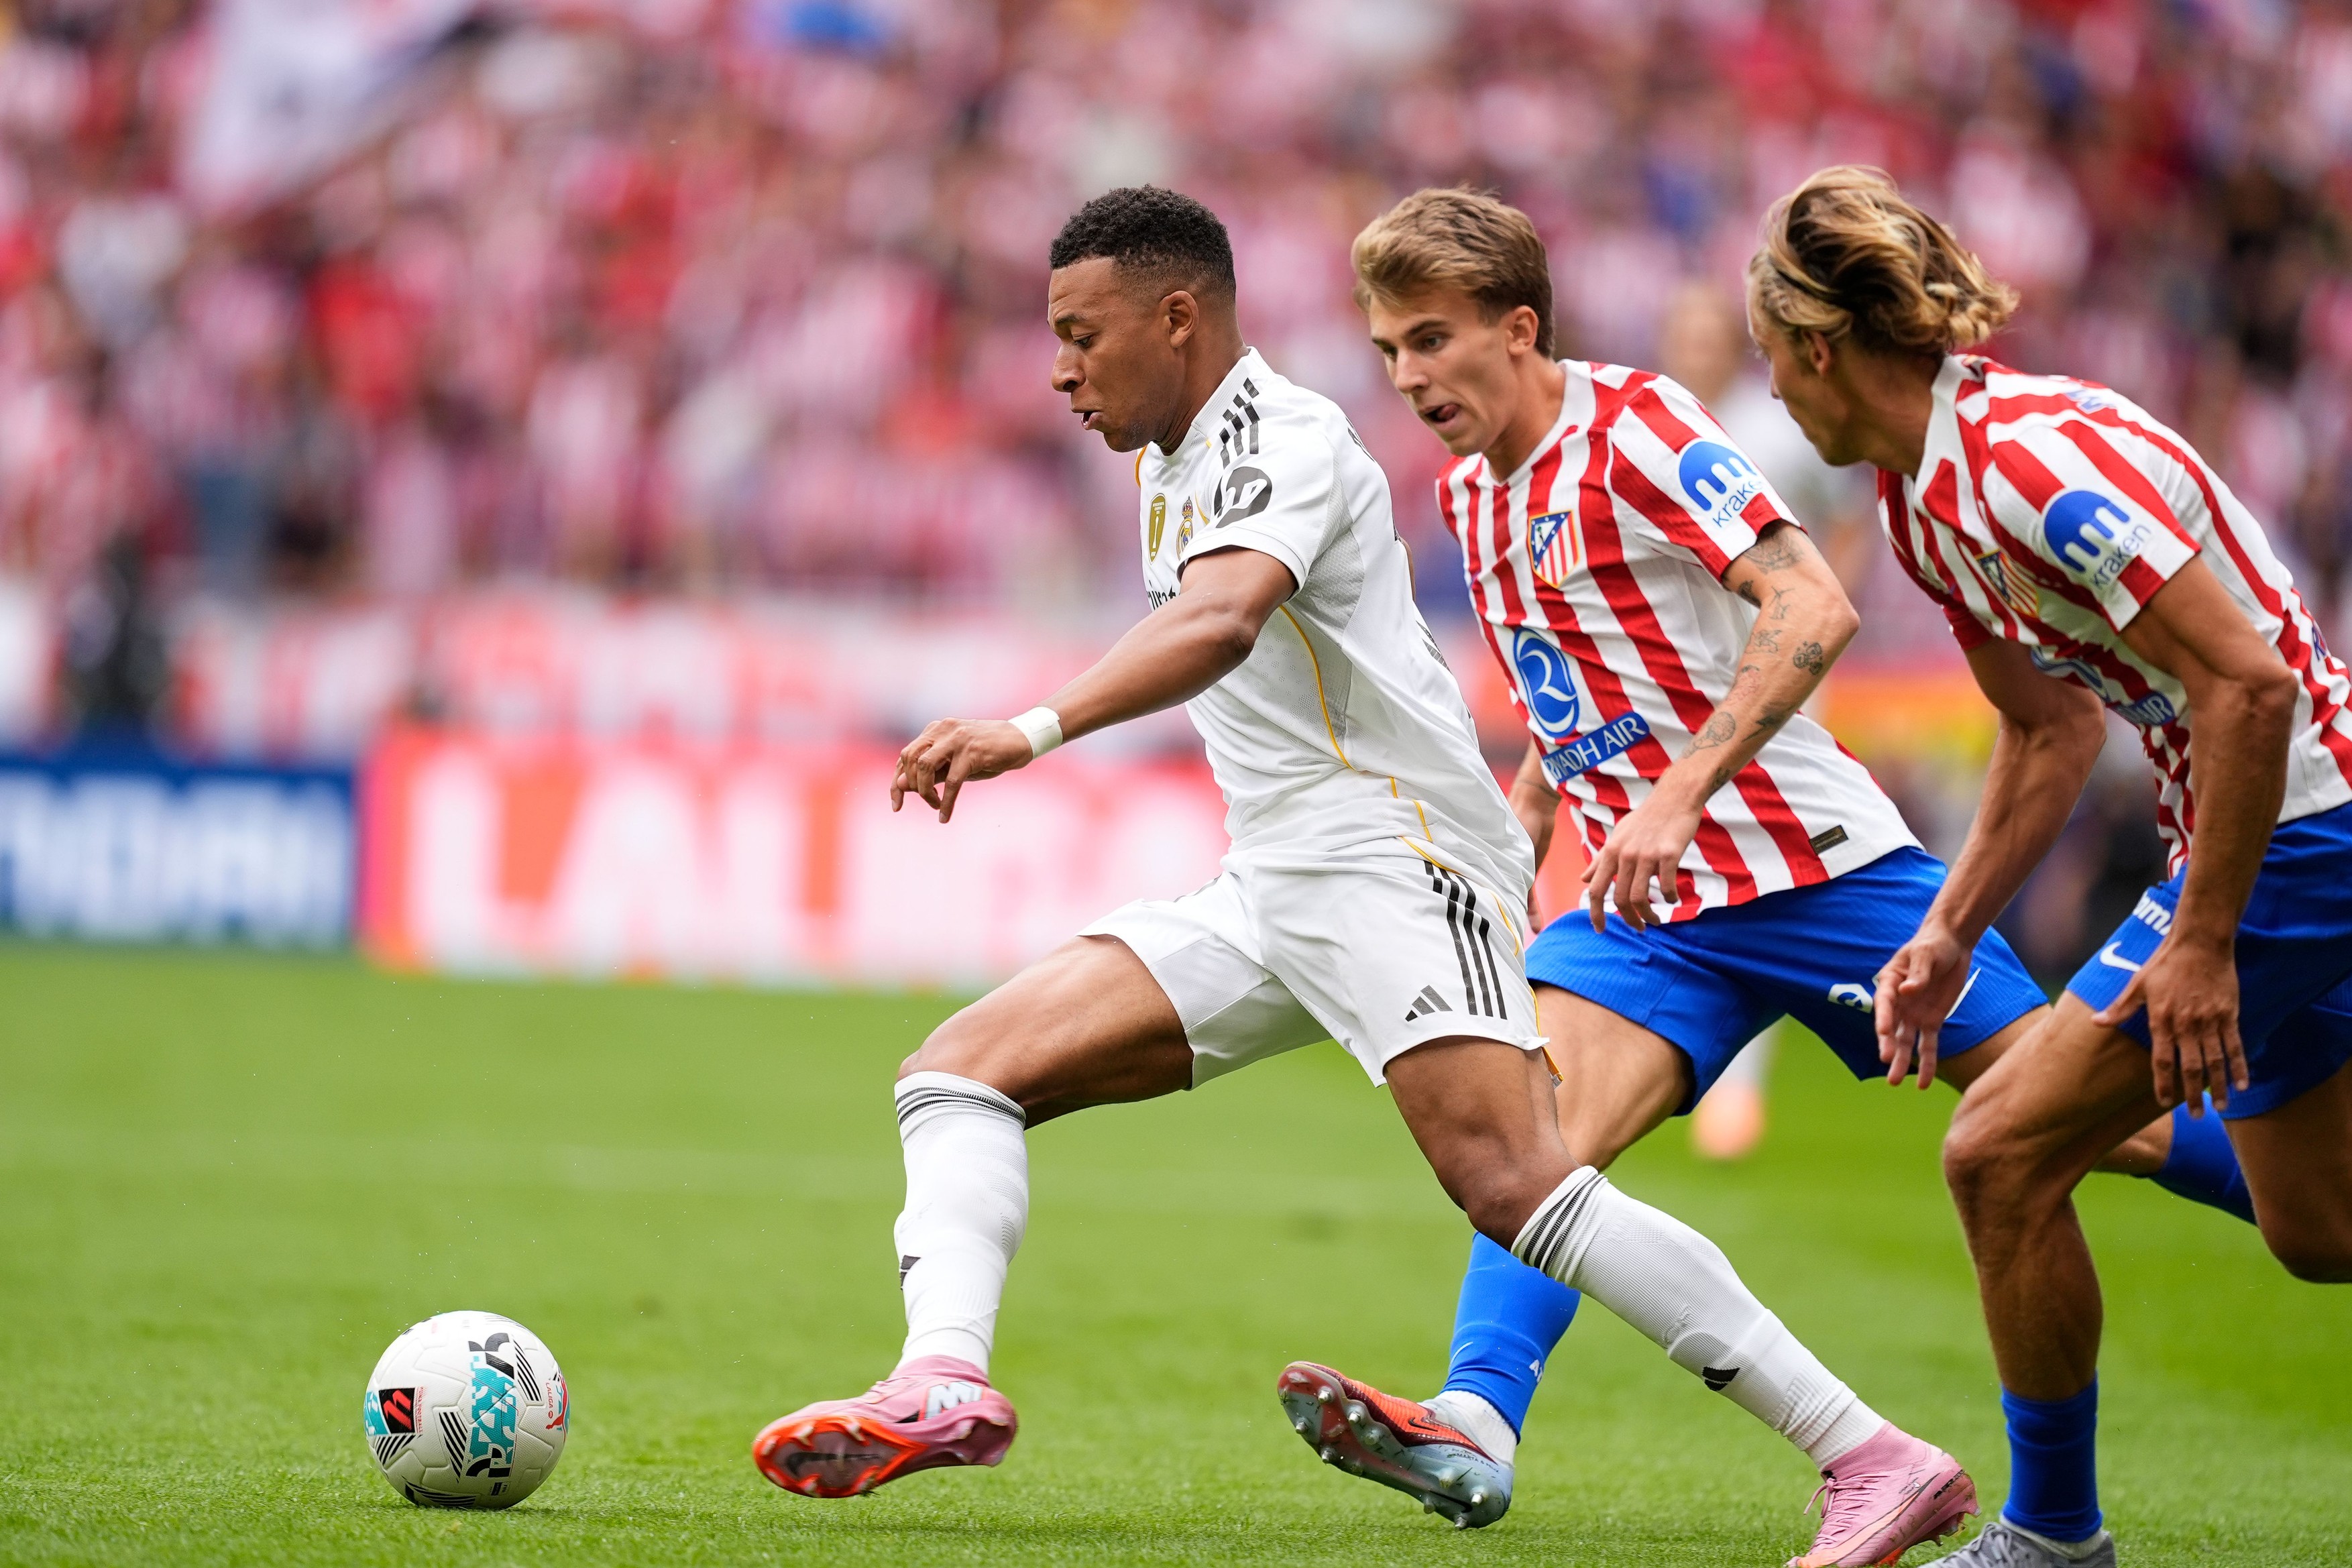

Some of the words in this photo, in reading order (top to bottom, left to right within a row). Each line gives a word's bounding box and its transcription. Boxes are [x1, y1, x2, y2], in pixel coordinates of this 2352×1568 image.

[1712, 480, 1763, 528] krake
[2091, 524, 2152, 590] kraken
[1603, 718, 1646, 755] AIR
[545, 1382, 553, 1409] LALIGA
